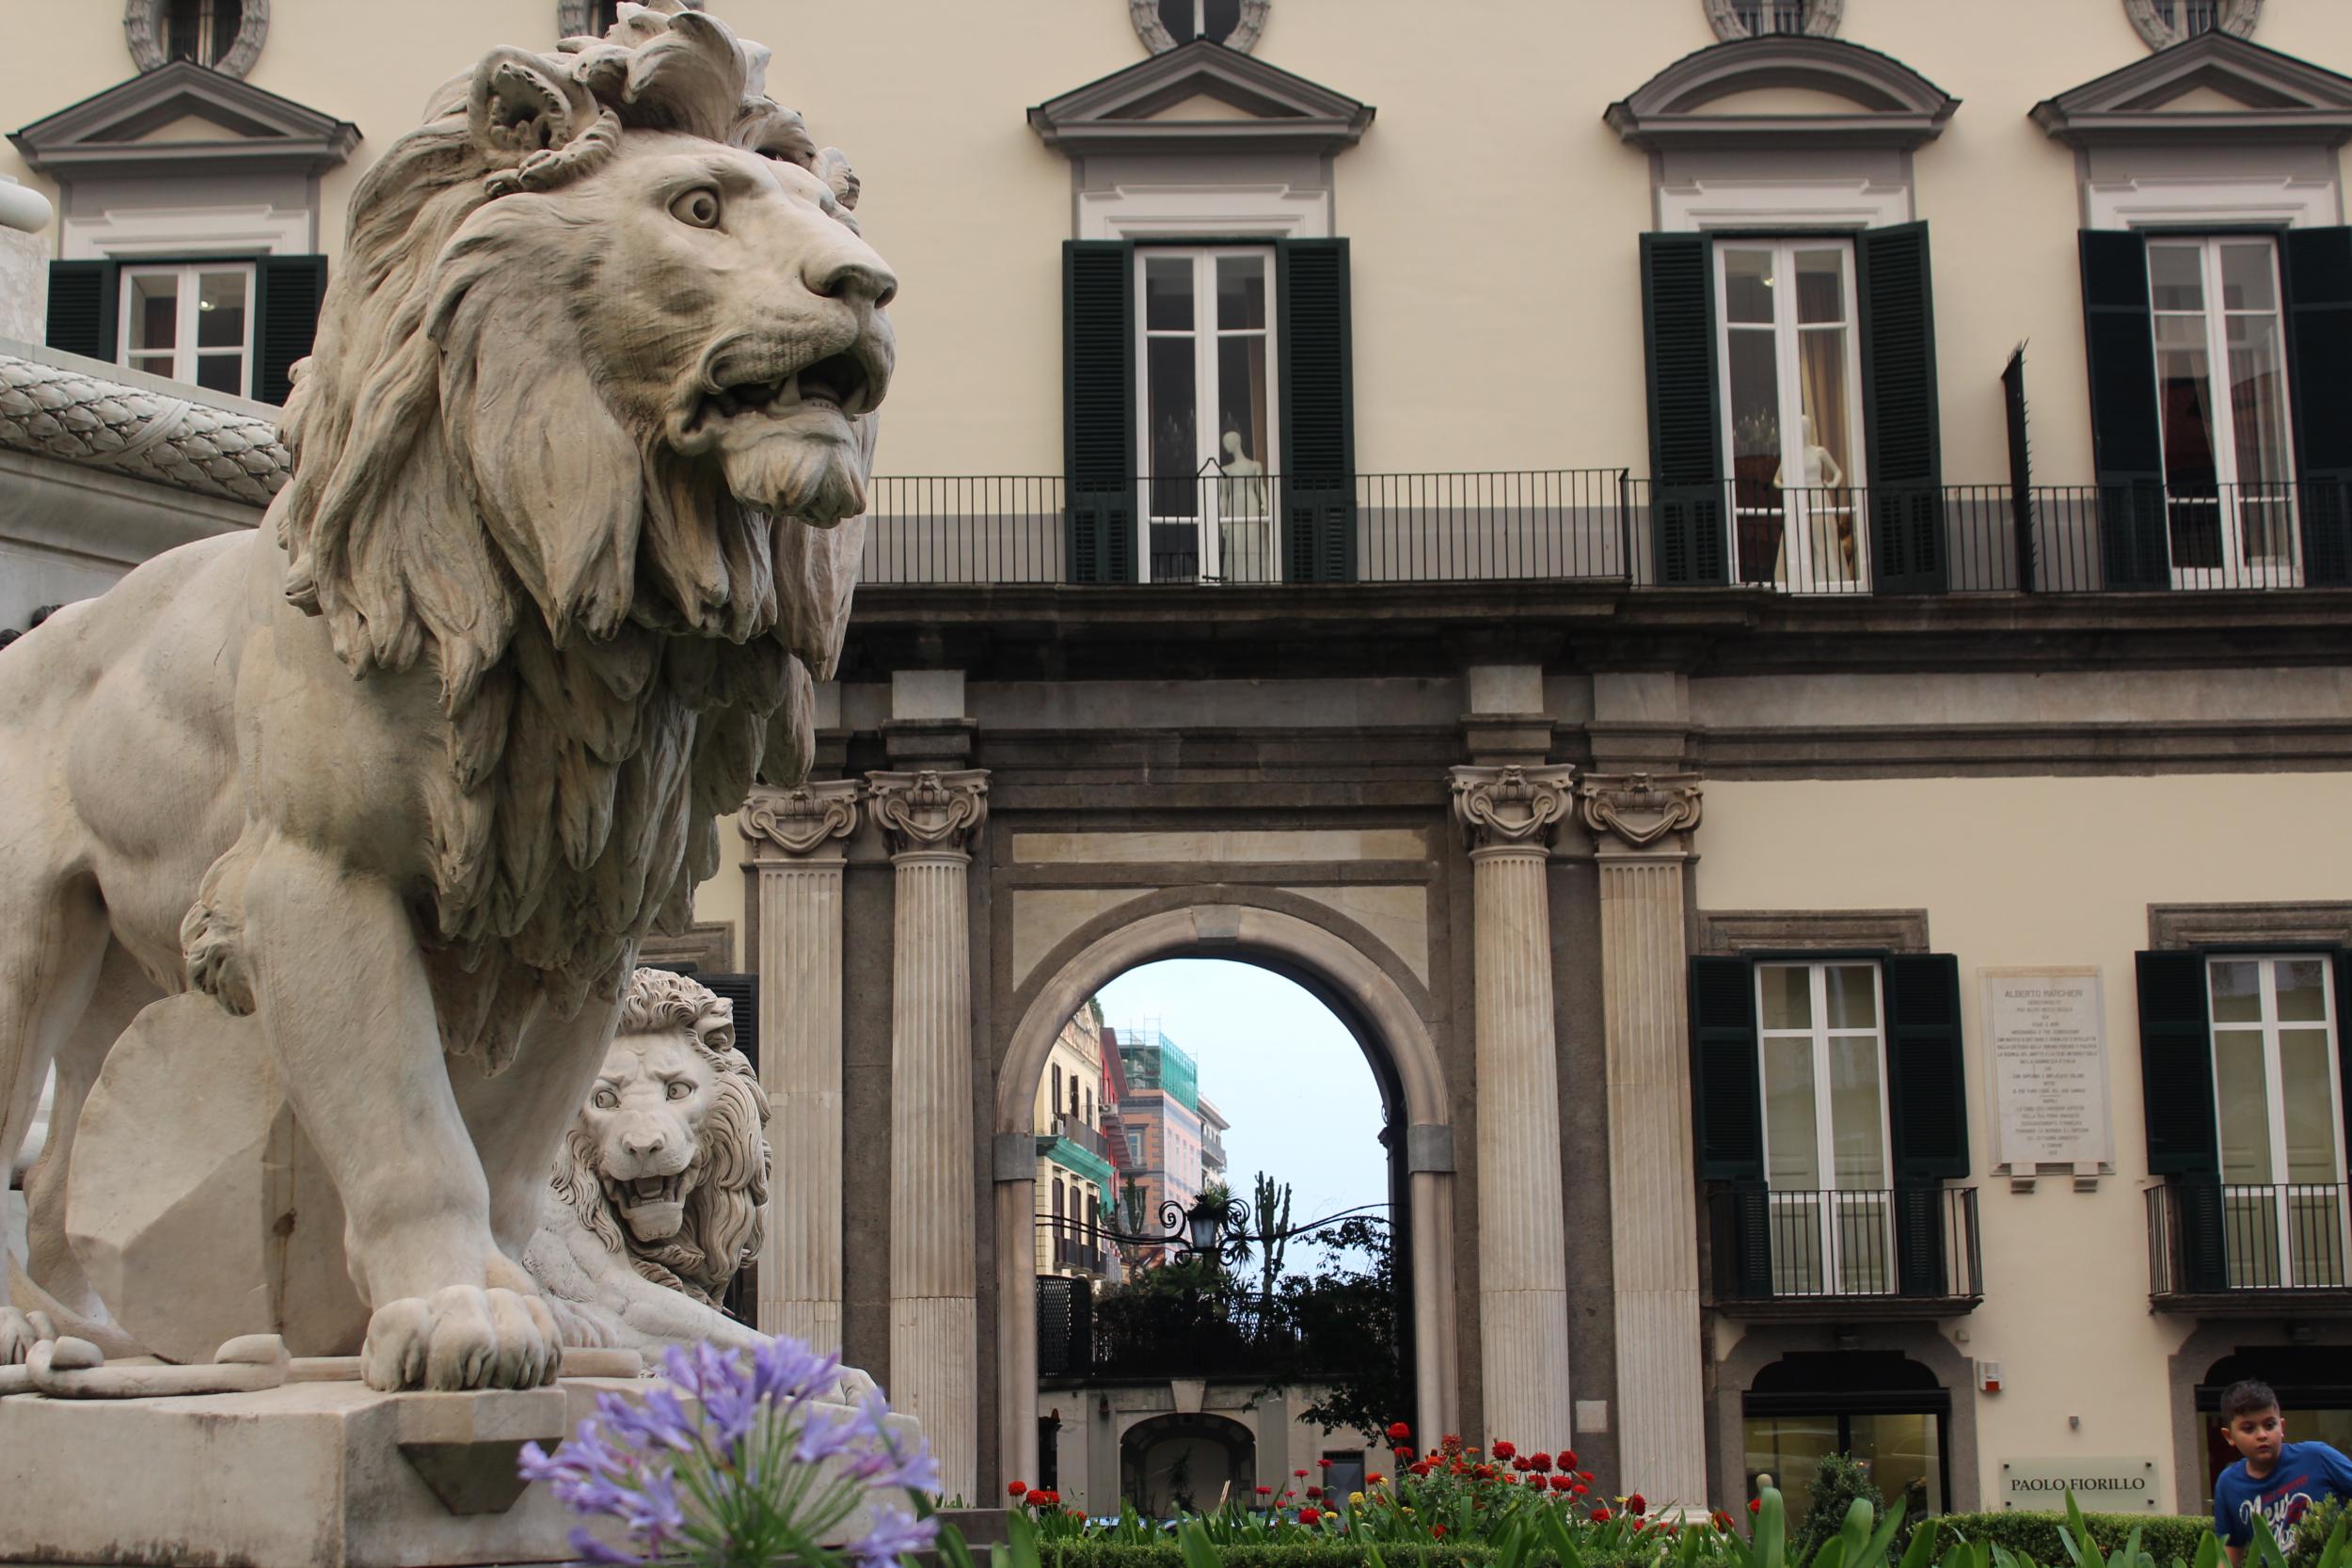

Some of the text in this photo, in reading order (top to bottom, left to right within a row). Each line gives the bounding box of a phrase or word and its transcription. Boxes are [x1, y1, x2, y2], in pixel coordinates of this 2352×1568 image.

[2005, 990, 2041, 998] ALBERTO
[2011, 1478, 2145, 1491] PAOLO FIORILLO
[2239, 1492, 2290, 1528] New
